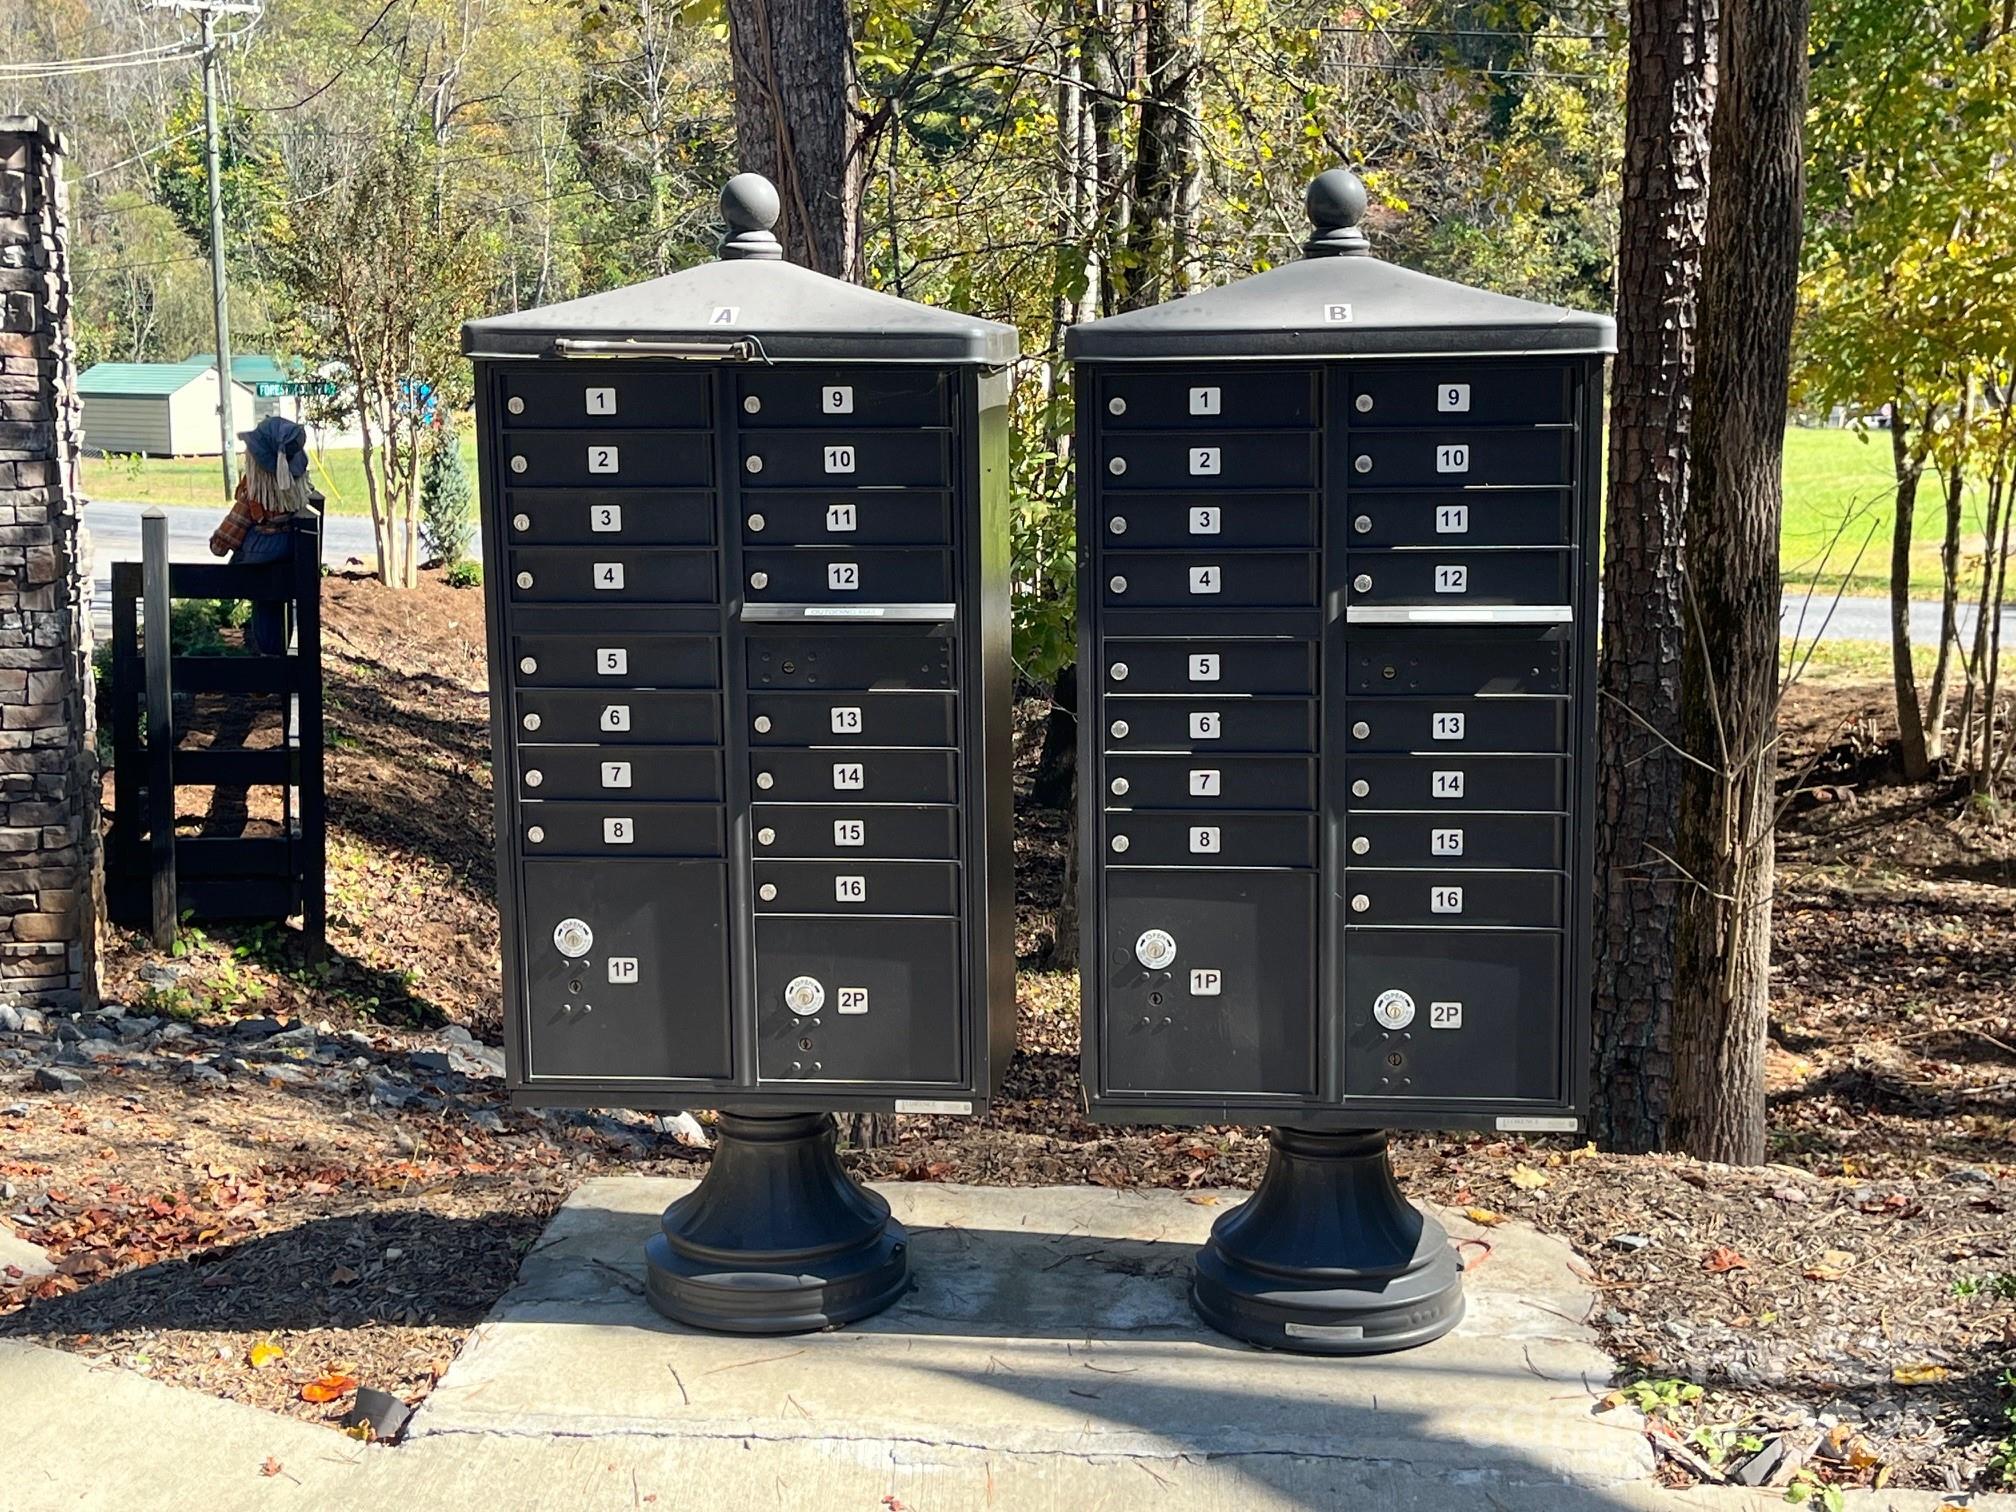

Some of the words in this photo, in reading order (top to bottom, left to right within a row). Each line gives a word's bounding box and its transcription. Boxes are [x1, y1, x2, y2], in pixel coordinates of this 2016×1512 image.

[714, 309, 731, 323] A
[1330, 306, 1347, 320] B
[595, 392, 604, 409] 1
[832, 391, 843, 408] 9
[1199, 391, 1208, 408] 1
[1448, 388, 1460, 406] 9
[597, 450, 609, 468] 2
[828, 450, 851, 467] 10
[1199, 451, 1211, 468] 2
[1440, 449, 1465, 467] 10
[601, 509, 612, 526] 3
[830, 509, 851, 525] 11
[1199, 511, 1210, 528] 3
[1440, 509, 1462, 527] 11
[603, 567, 615, 583] 4
[832, 567, 855, 584] 12
[1199, 570, 1211, 587] 4
[1439, 570, 1463, 587] 12
[607, 653, 618, 669] 5
[1199, 658, 1210, 675] 5
[609, 709, 620, 726] 6
[835, 711, 858, 728] 13
[1199, 716, 1211, 733] 6
[1436, 717, 1460, 734] 13
[611, 766, 622, 782] 7
[837, 767, 860, 784] 14
[1199, 774, 1211, 790] 7
[1436, 775, 1460, 792] 14
[613, 822, 624, 838] 8
[838, 824, 861, 840] 15
[1199, 831, 1210, 847] 8
[1435, 833, 1459, 850] 15
[839, 880, 862, 896] 16
[1435, 891, 1459, 908] 16
[612, 961, 635, 977] 1P
[1194, 972, 1218, 989] 1P
[841, 992, 865, 1007] 2P
[1434, 1006, 1459, 1022] 2P
